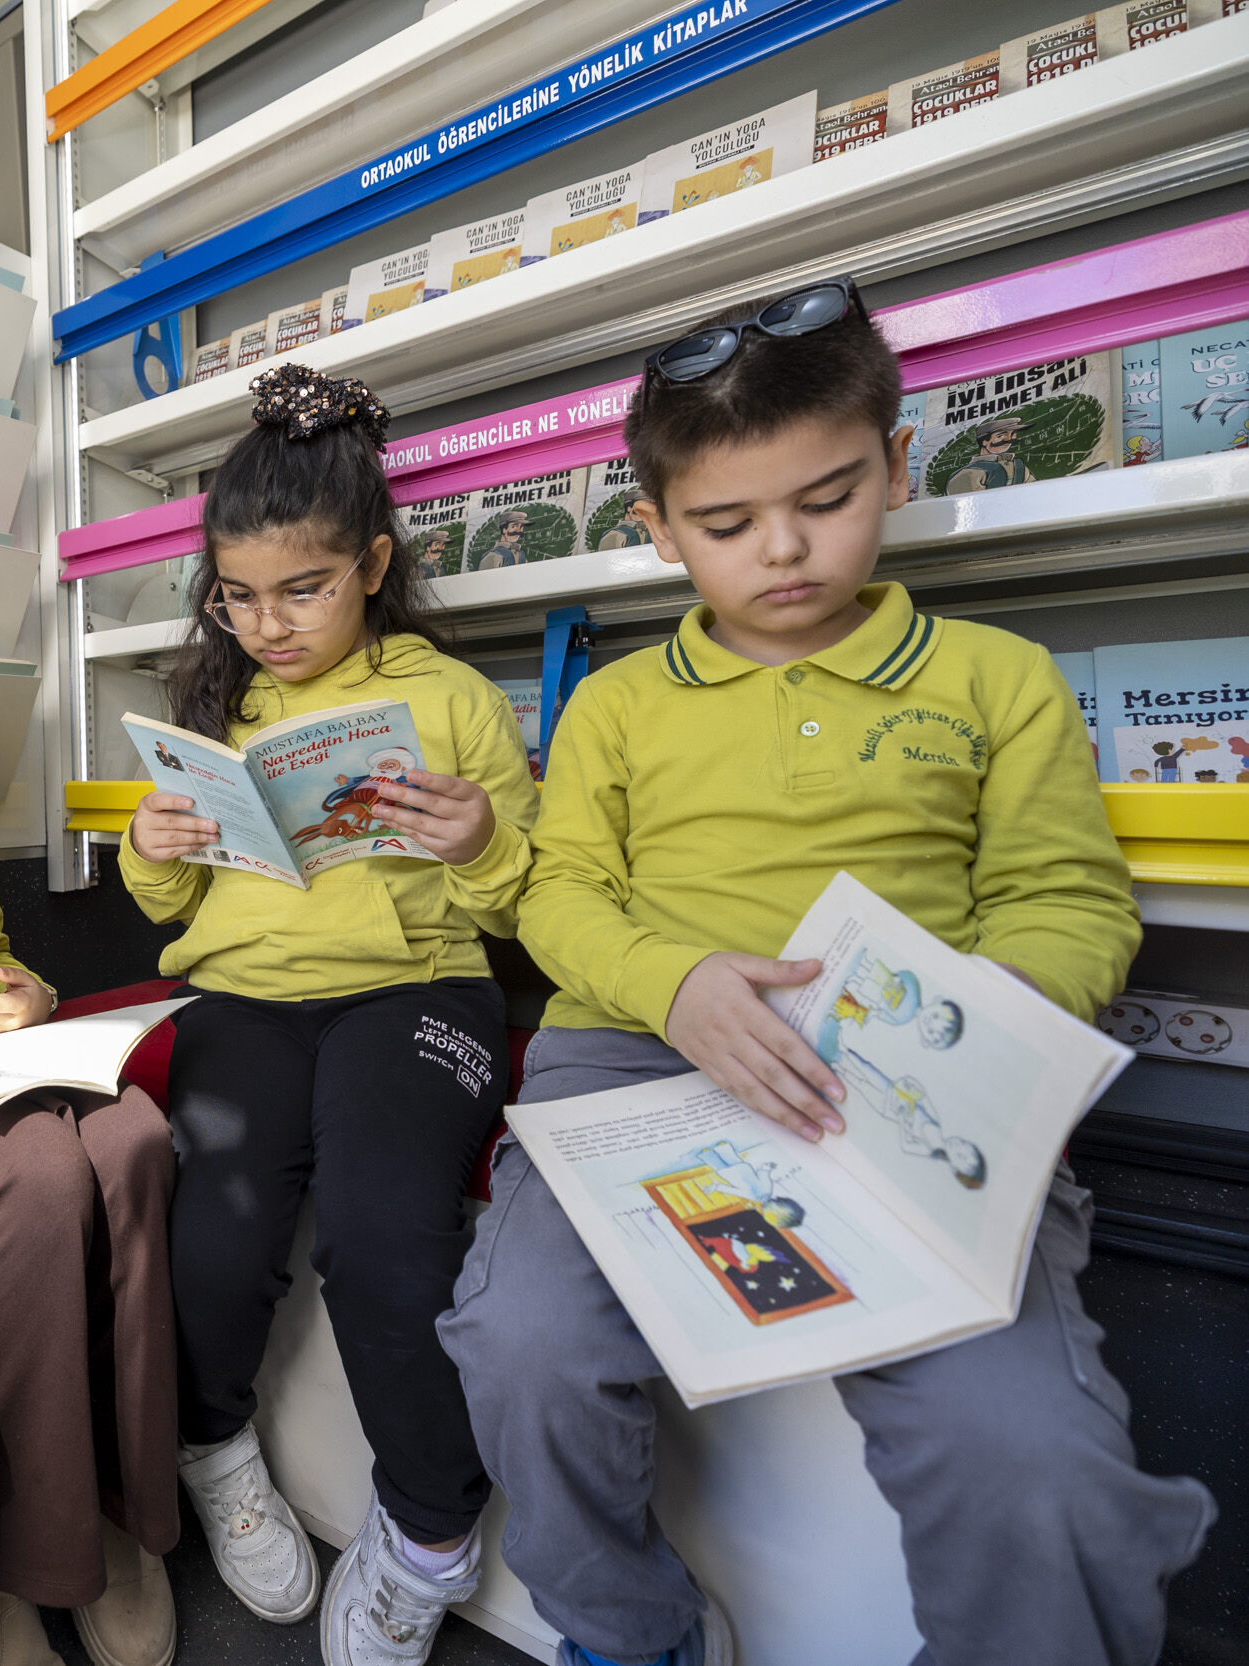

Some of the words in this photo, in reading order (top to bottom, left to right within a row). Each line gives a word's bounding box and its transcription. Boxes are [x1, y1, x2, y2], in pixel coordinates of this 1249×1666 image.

[1036, 35, 1073, 52] Ataol
[360, 141, 431, 189] ORTAOKUL
[437, 81, 560, 155] ÖĞRENCİLERİNE
[568, 40, 643, 94] YÖNELİK
[653, 0, 748, 55] KİTAPLAR
[913, 79, 998, 116] ÇOCUKLAR
[920, 79, 953, 95] Ataol
[736, 117, 766, 137] YOGA
[844, 105, 888, 123] Behram
[694, 130, 760, 164] YOLCULUĞU
[605, 172, 632, 189] YOGA
[502, 213, 525, 227] YOGA
[413, 248, 430, 262] YOG
[945, 381, 1047, 426] MEHMET
[1052, 357, 1087, 392] ALİ
[481, 485, 546, 509] MEHMET
[547, 479, 571, 498] ALİ
[409, 506, 466, 527] MEHMET
[255, 727, 324, 759] MUSTAFA
[326, 711, 388, 733] BALBAY
[262, 736, 344, 771] Nasreddin
[348, 725, 391, 742] Hoca
[267, 765, 287, 780] ile
[290, 748, 330, 771] Eşeği
[421, 1015, 448, 1032] PME
[452, 1027, 492, 1062] LEGEND
[423, 1024, 442, 1037] LEFT
[414, 1031, 492, 1085] PROPELLER
[418, 1050, 454, 1071] SWITCH
[460, 1071, 479, 1092] ON
